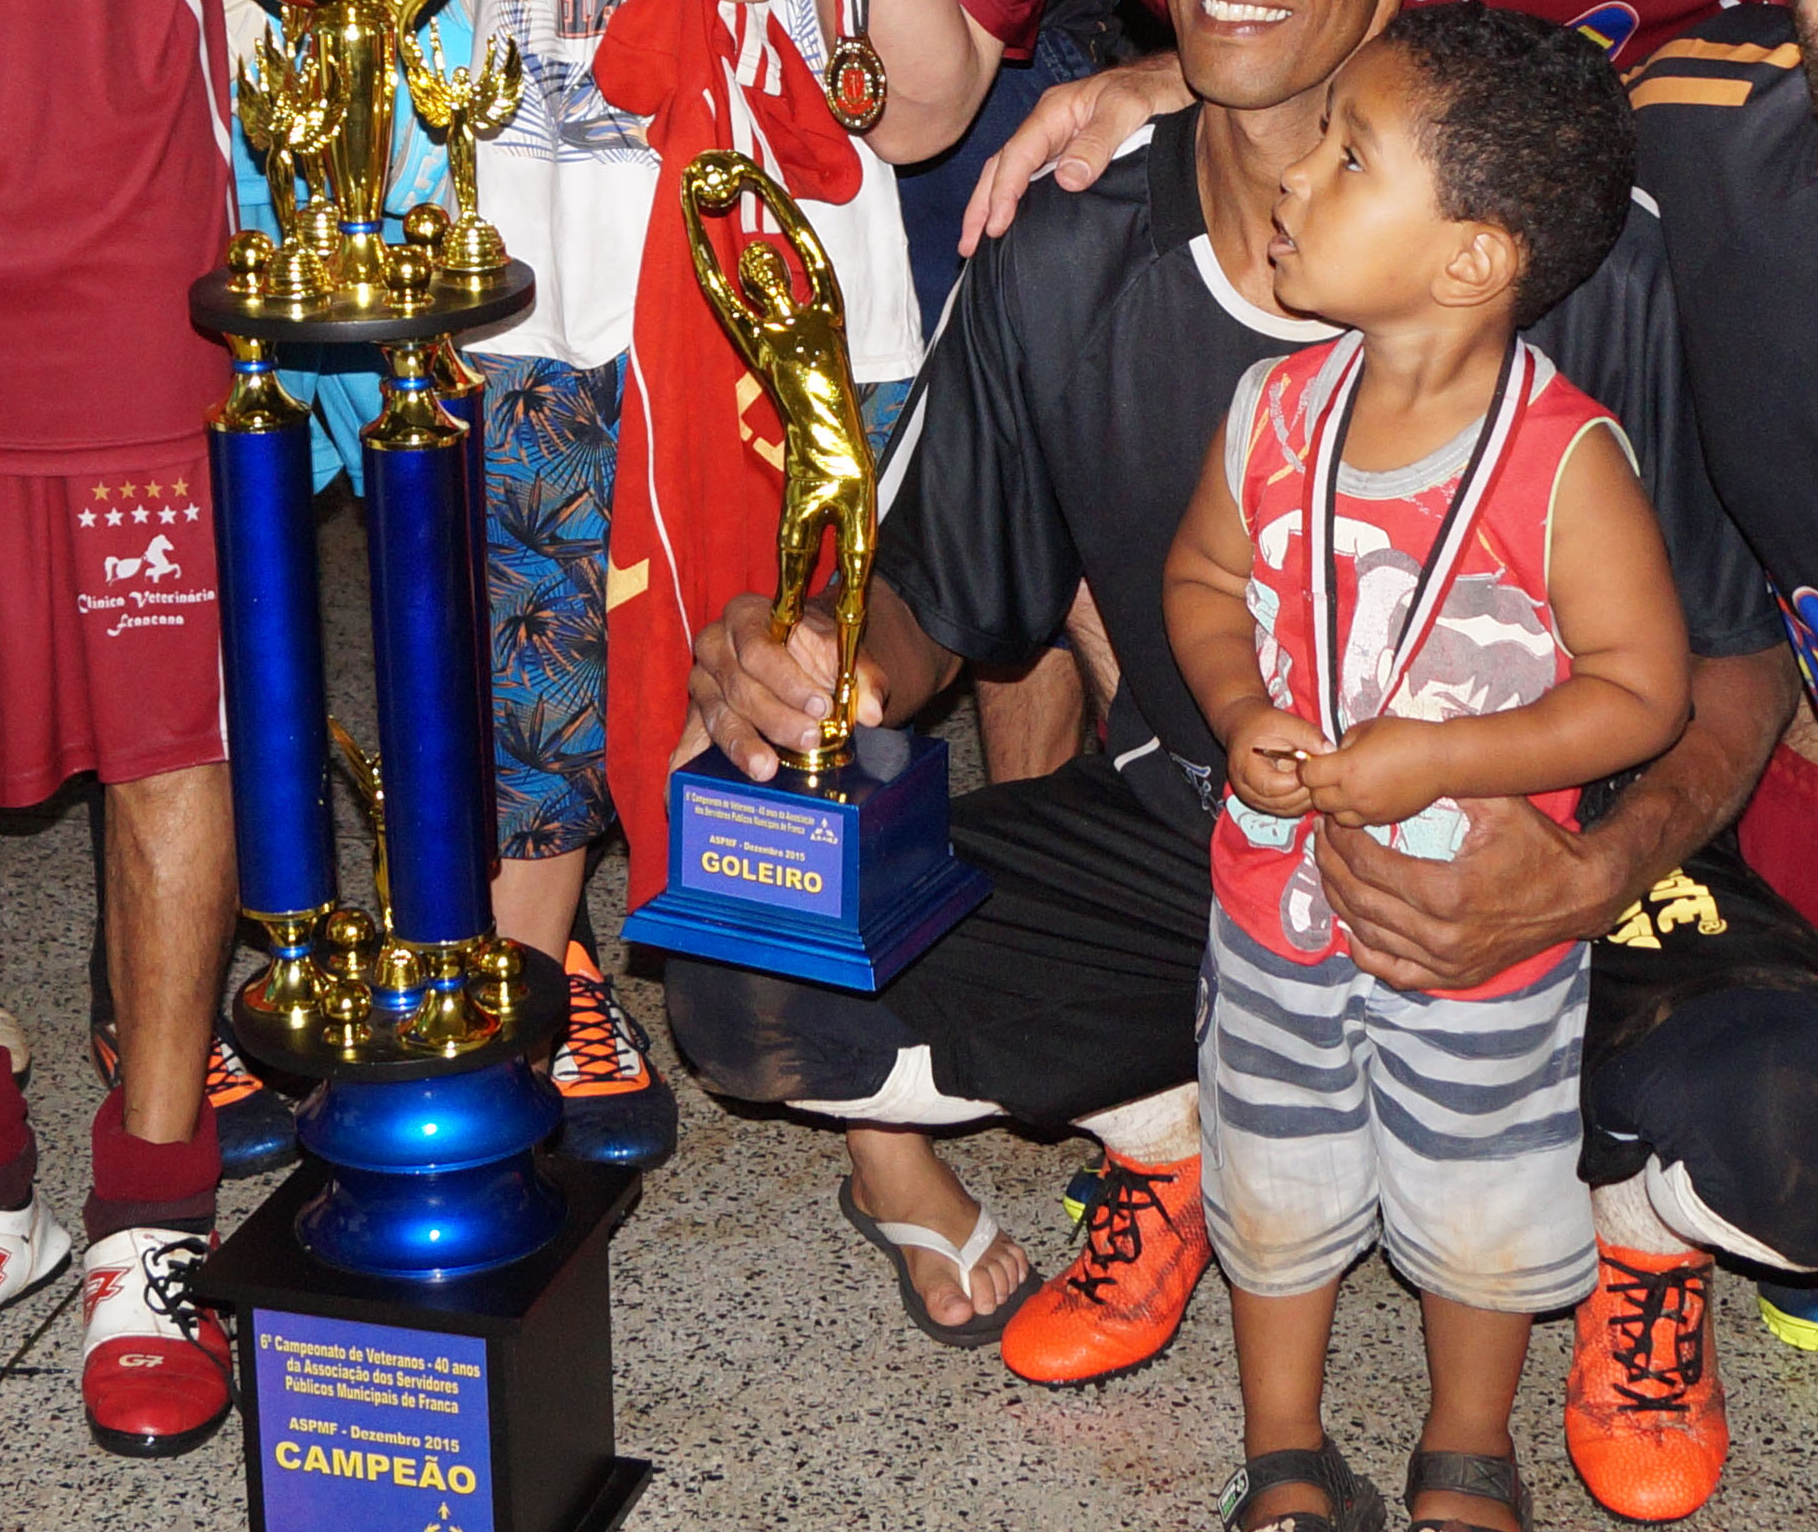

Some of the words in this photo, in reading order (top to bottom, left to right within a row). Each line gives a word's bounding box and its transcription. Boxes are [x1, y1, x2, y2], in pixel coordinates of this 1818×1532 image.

[700, 851, 823, 893] GOLEIRO
[118, 1353, 166, 1368] G7
[275, 1335, 346, 1361] Campeonato
[348, 1346, 363, 1361] de
[366, 1348, 425, 1371] Veteranos
[434, 1358, 449, 1373] 40
[452, 1362, 480, 1378] anos
[287, 1357, 301, 1373] da
[304, 1359, 369, 1384] Associação
[372, 1370, 394, 1386] dos
[396, 1372, 459, 1394] Servidores
[285, 1376, 334, 1397] Públicos
[337, 1383, 398, 1407] Municipais
[401, 1393, 416, 1408] de
[418, 1394, 459, 1414] Franca
[289, 1417, 338, 1436] ASPMF
[350, 1425, 421, 1448] Dezembro
[424, 1436, 460, 1452] 2015
[275, 1441, 477, 1495] CAMPEÃO
